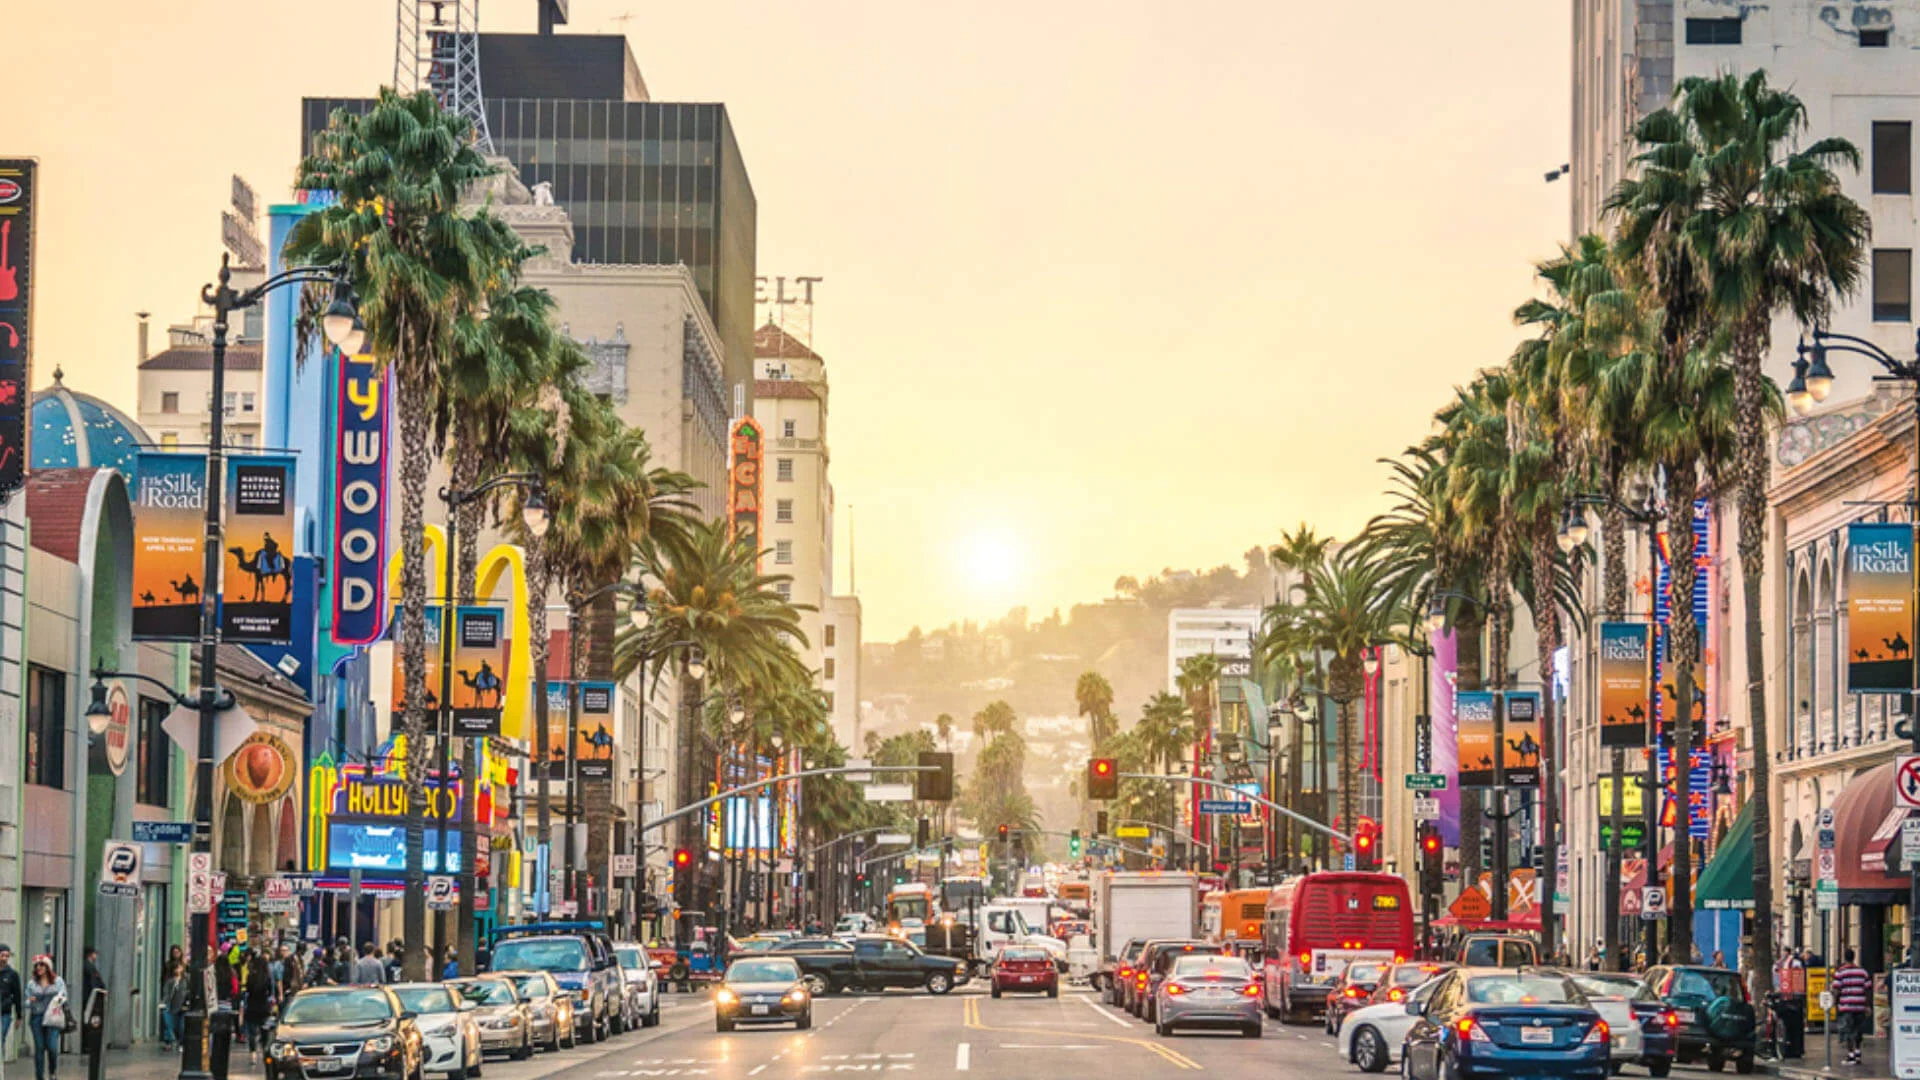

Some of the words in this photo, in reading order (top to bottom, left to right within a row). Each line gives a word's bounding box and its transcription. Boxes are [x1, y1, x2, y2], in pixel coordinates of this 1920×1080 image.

[164, 473, 197, 494] Silk
[341, 352, 380, 612] YWOOD
[148, 487, 203, 508] Road
[1872, 541, 1904, 559] Silk
[1859, 552, 1909, 573] Road
[1608, 645, 1645, 659] Road
